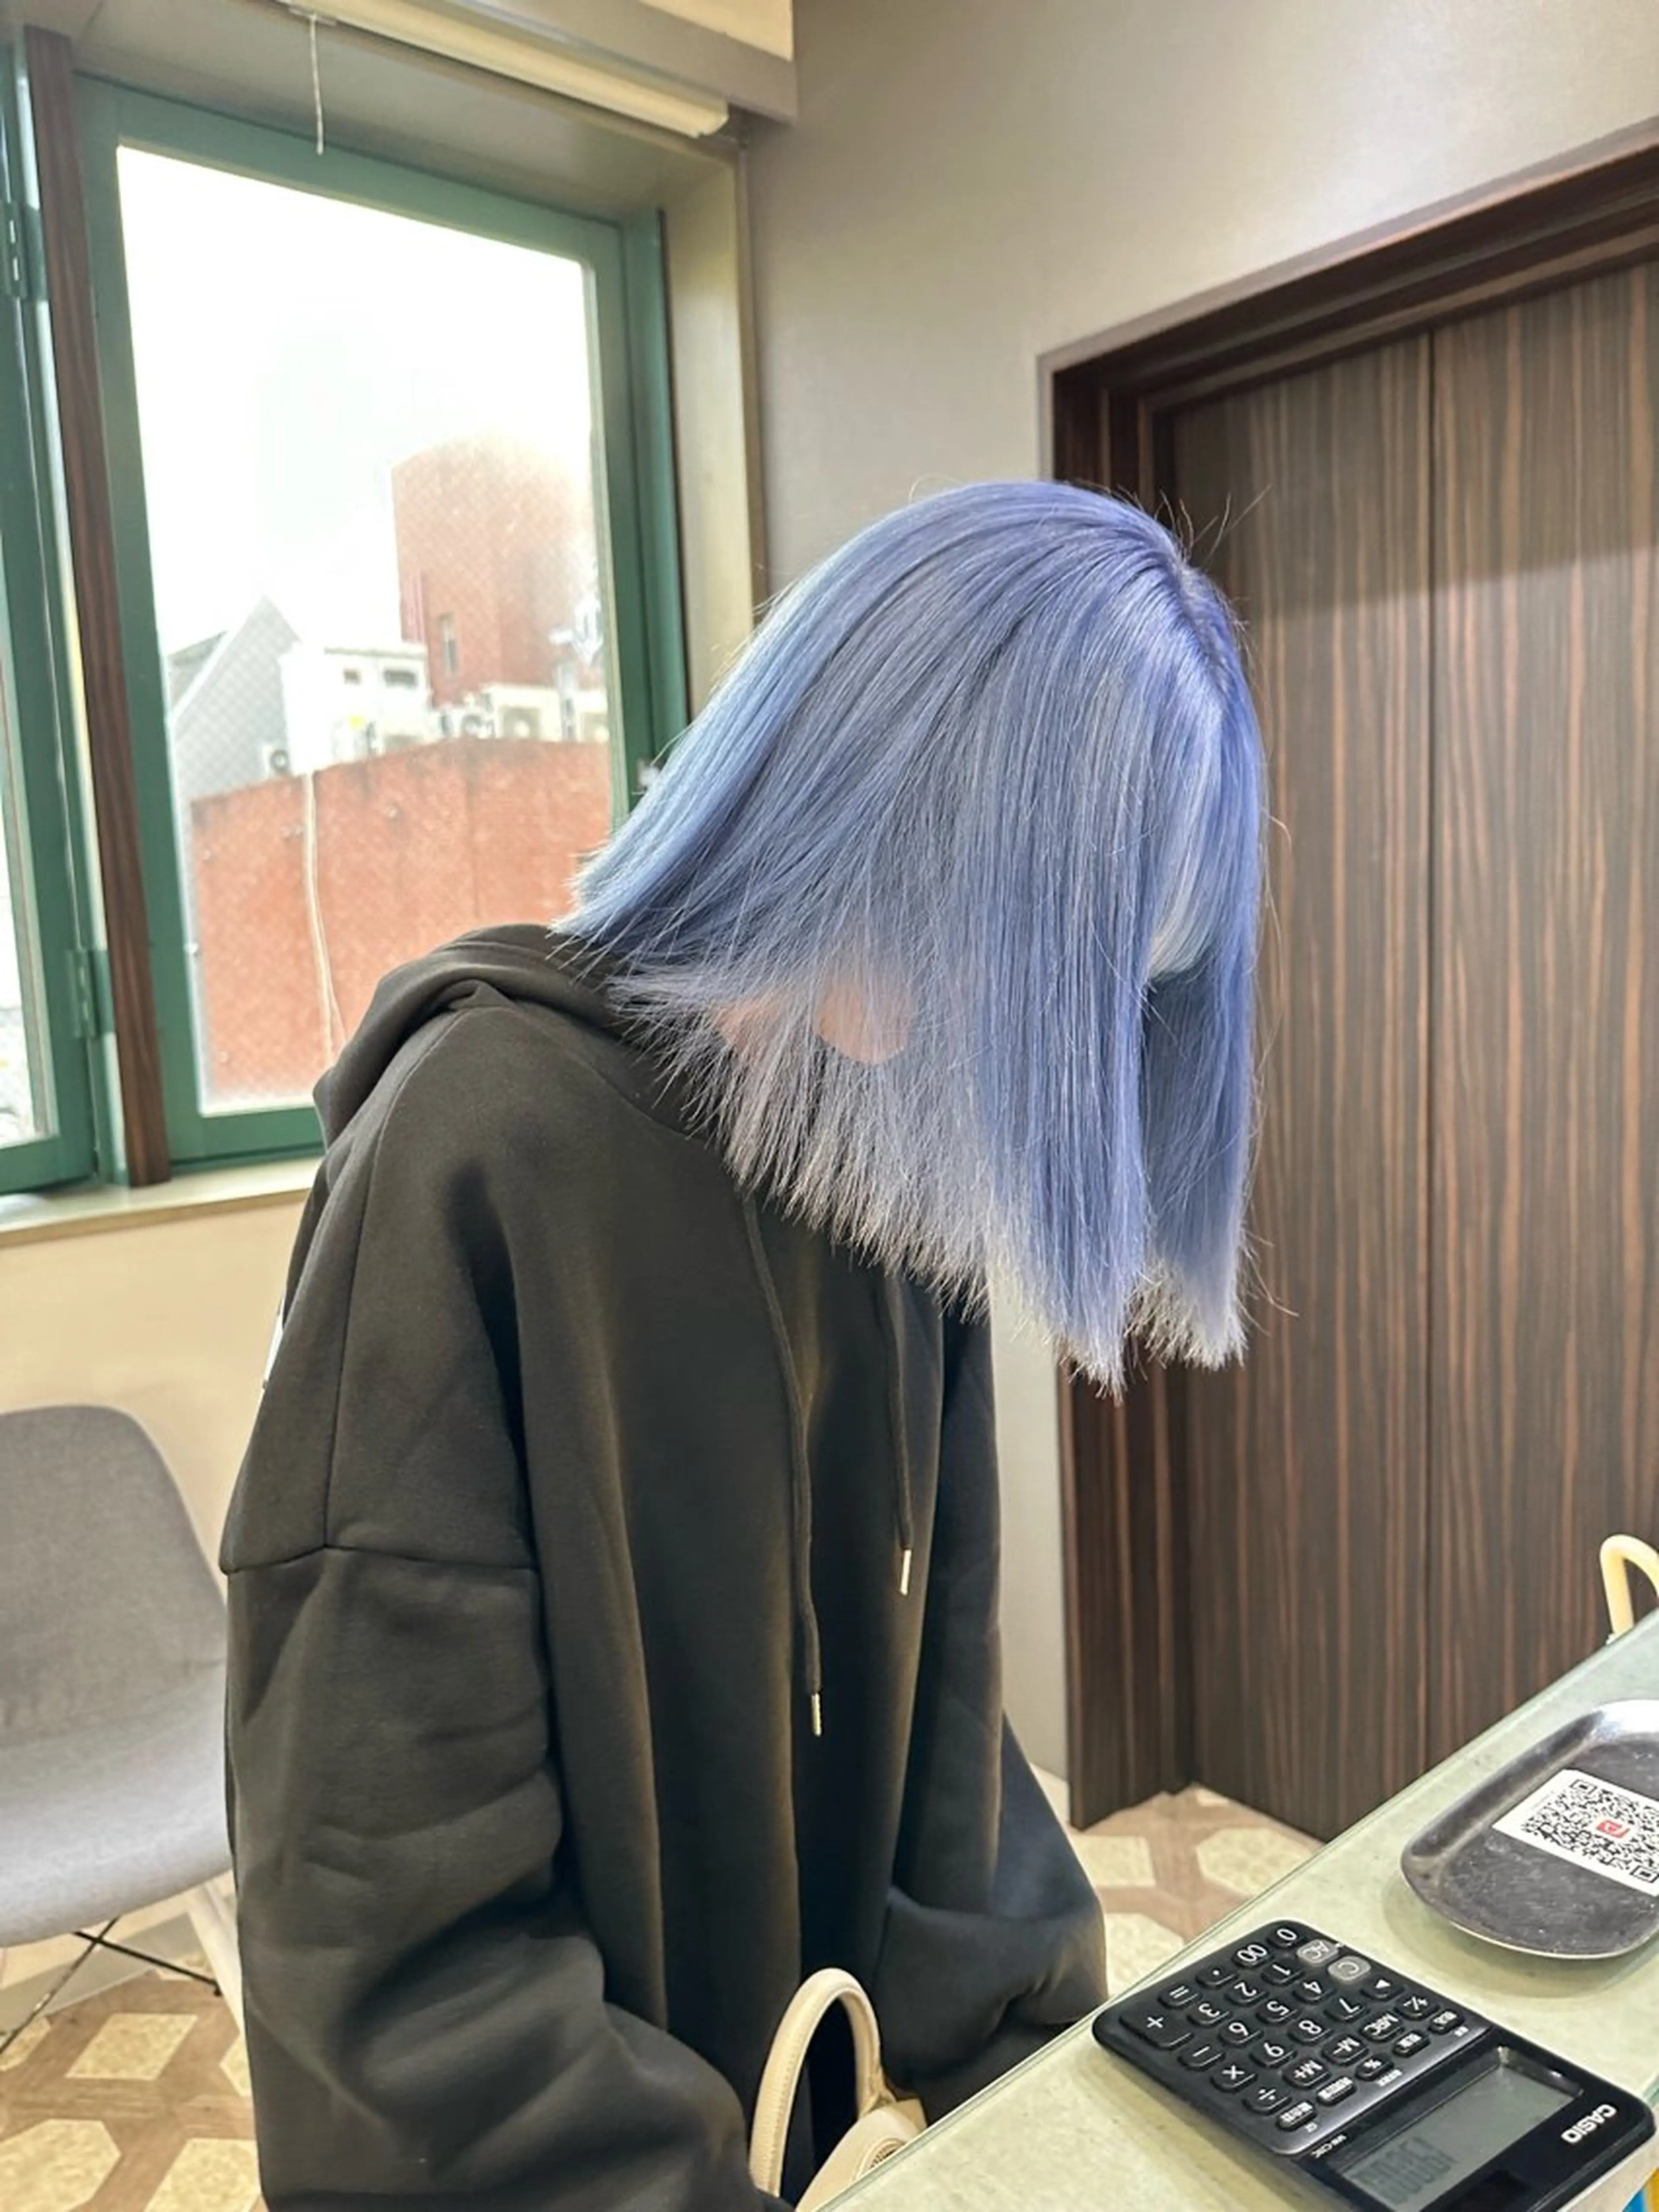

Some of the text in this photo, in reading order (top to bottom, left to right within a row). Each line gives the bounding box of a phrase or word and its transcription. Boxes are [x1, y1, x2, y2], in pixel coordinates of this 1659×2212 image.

[1277, 1928, 1297, 1940] 0
[1237, 1944, 1267, 1962] 00
[1302, 1941, 1329, 1959] AC
[1272, 1964, 1290, 1975] 1
[1338, 1961, 1359, 1974] C
[1234, 1982, 1257, 1996] 2
[1303, 1981, 1322, 1994] 4
[1198, 2003, 1220, 2017] 3
[1267, 2001, 1289, 2015] 5
[1339, 1998, 1360, 2013] 7
[1229, 2022, 1248, 2035] 6
[1299, 2020, 1322, 2034] 8
[1264, 2042, 1284, 2057] 9
[1561, 2104, 1618, 2145] CASIO
